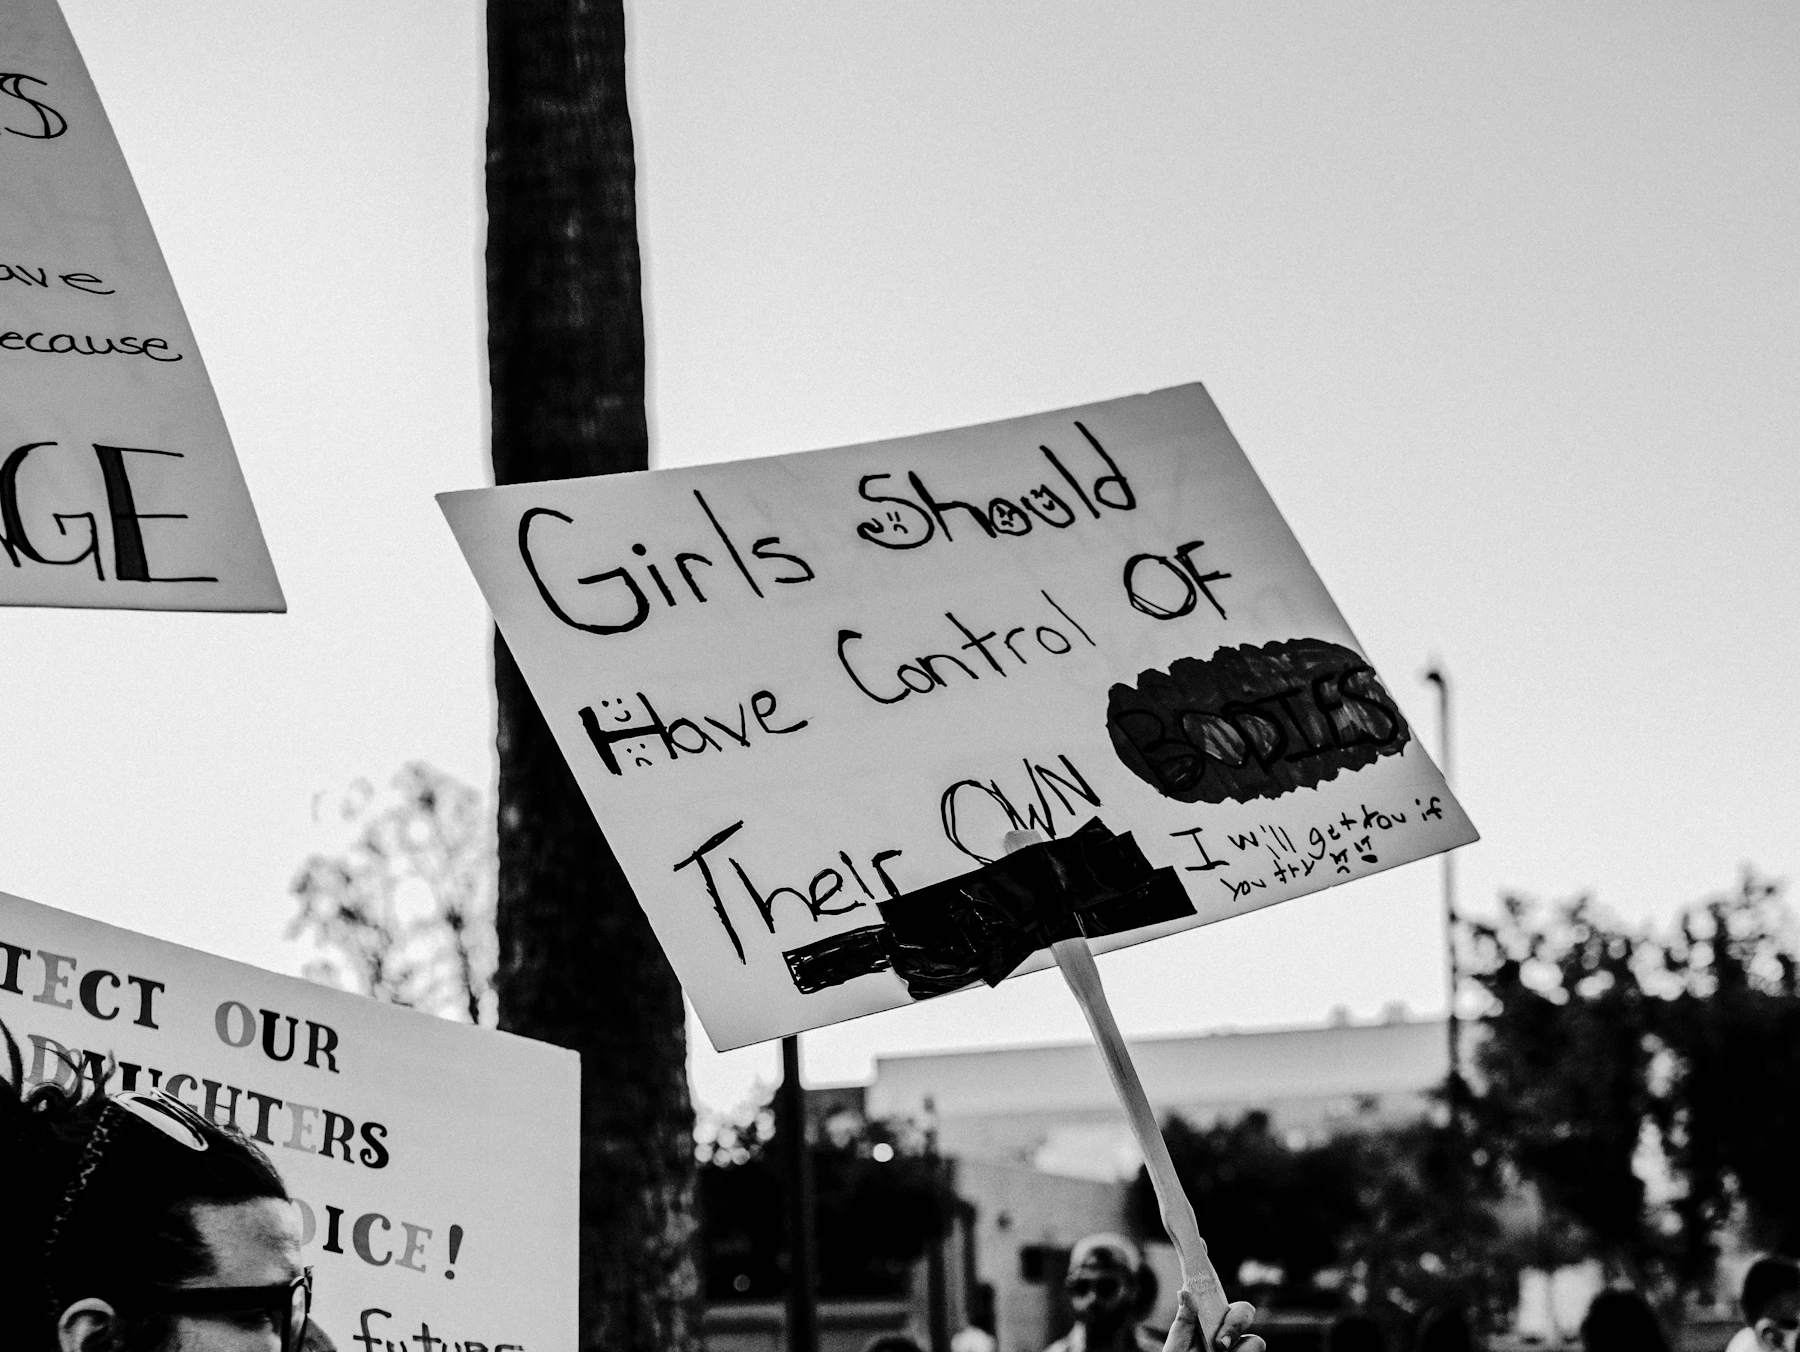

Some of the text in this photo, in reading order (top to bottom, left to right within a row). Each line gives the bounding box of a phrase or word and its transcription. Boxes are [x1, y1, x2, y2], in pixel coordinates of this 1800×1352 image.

[0, 331, 183, 362] ecause
[0, 442, 218, 582] GE
[518, 421, 1137, 635] Girls Should
[578, 690, 808, 776] Have
[837, 590, 1096, 704] Control
[673, 820, 902, 965] Their
[1169, 827, 1230, 871] I
[1414, 796, 1442, 821] if
[214, 1000, 341, 1074] OUR
